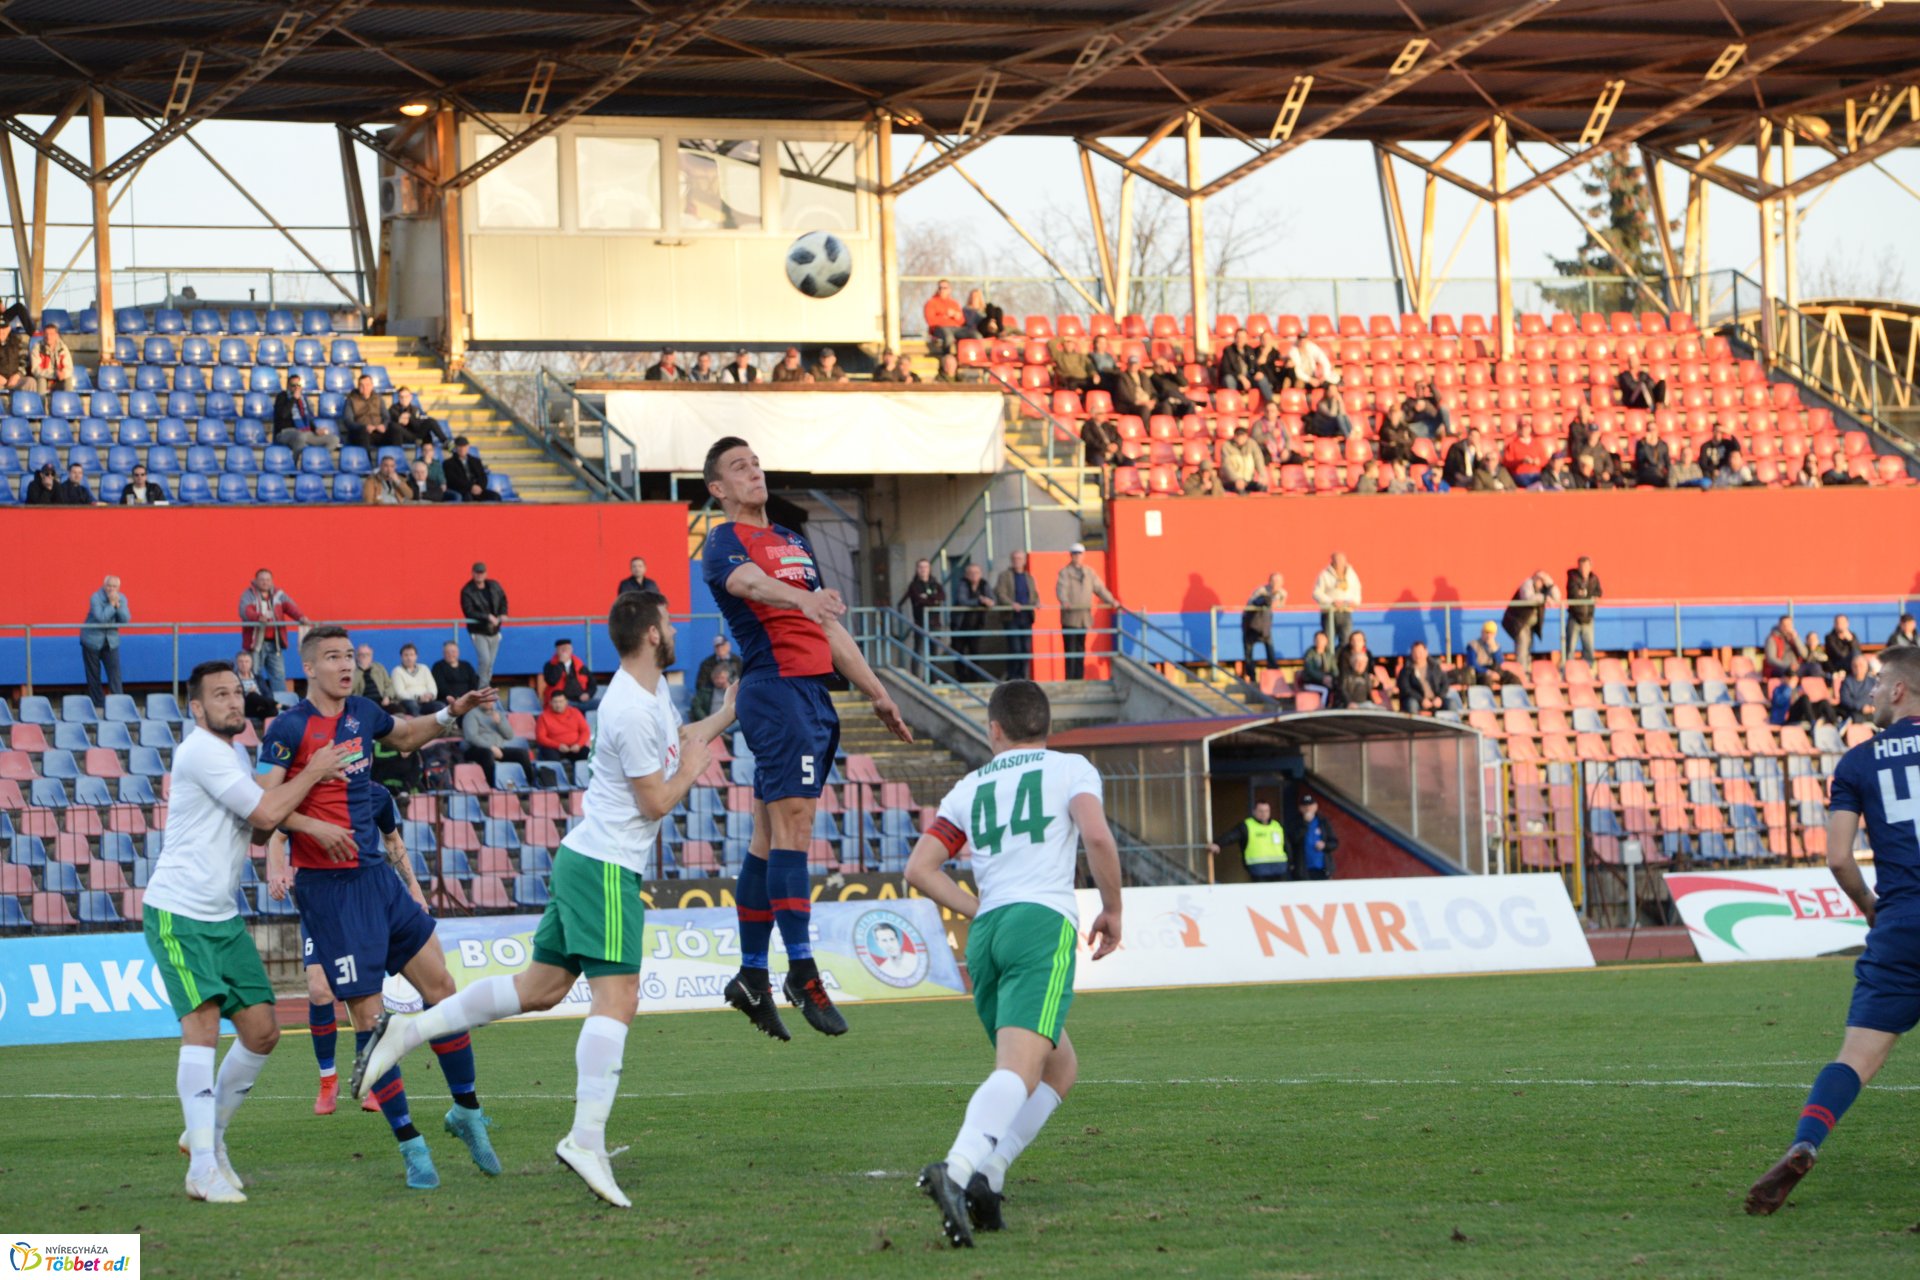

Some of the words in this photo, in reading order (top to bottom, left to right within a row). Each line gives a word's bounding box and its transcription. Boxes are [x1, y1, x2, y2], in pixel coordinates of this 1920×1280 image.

[801, 755, 815, 785] 5
[971, 769, 1056, 856] 44
[1246, 895, 1551, 958] NYIRLOG
[334, 954, 358, 985] 31
